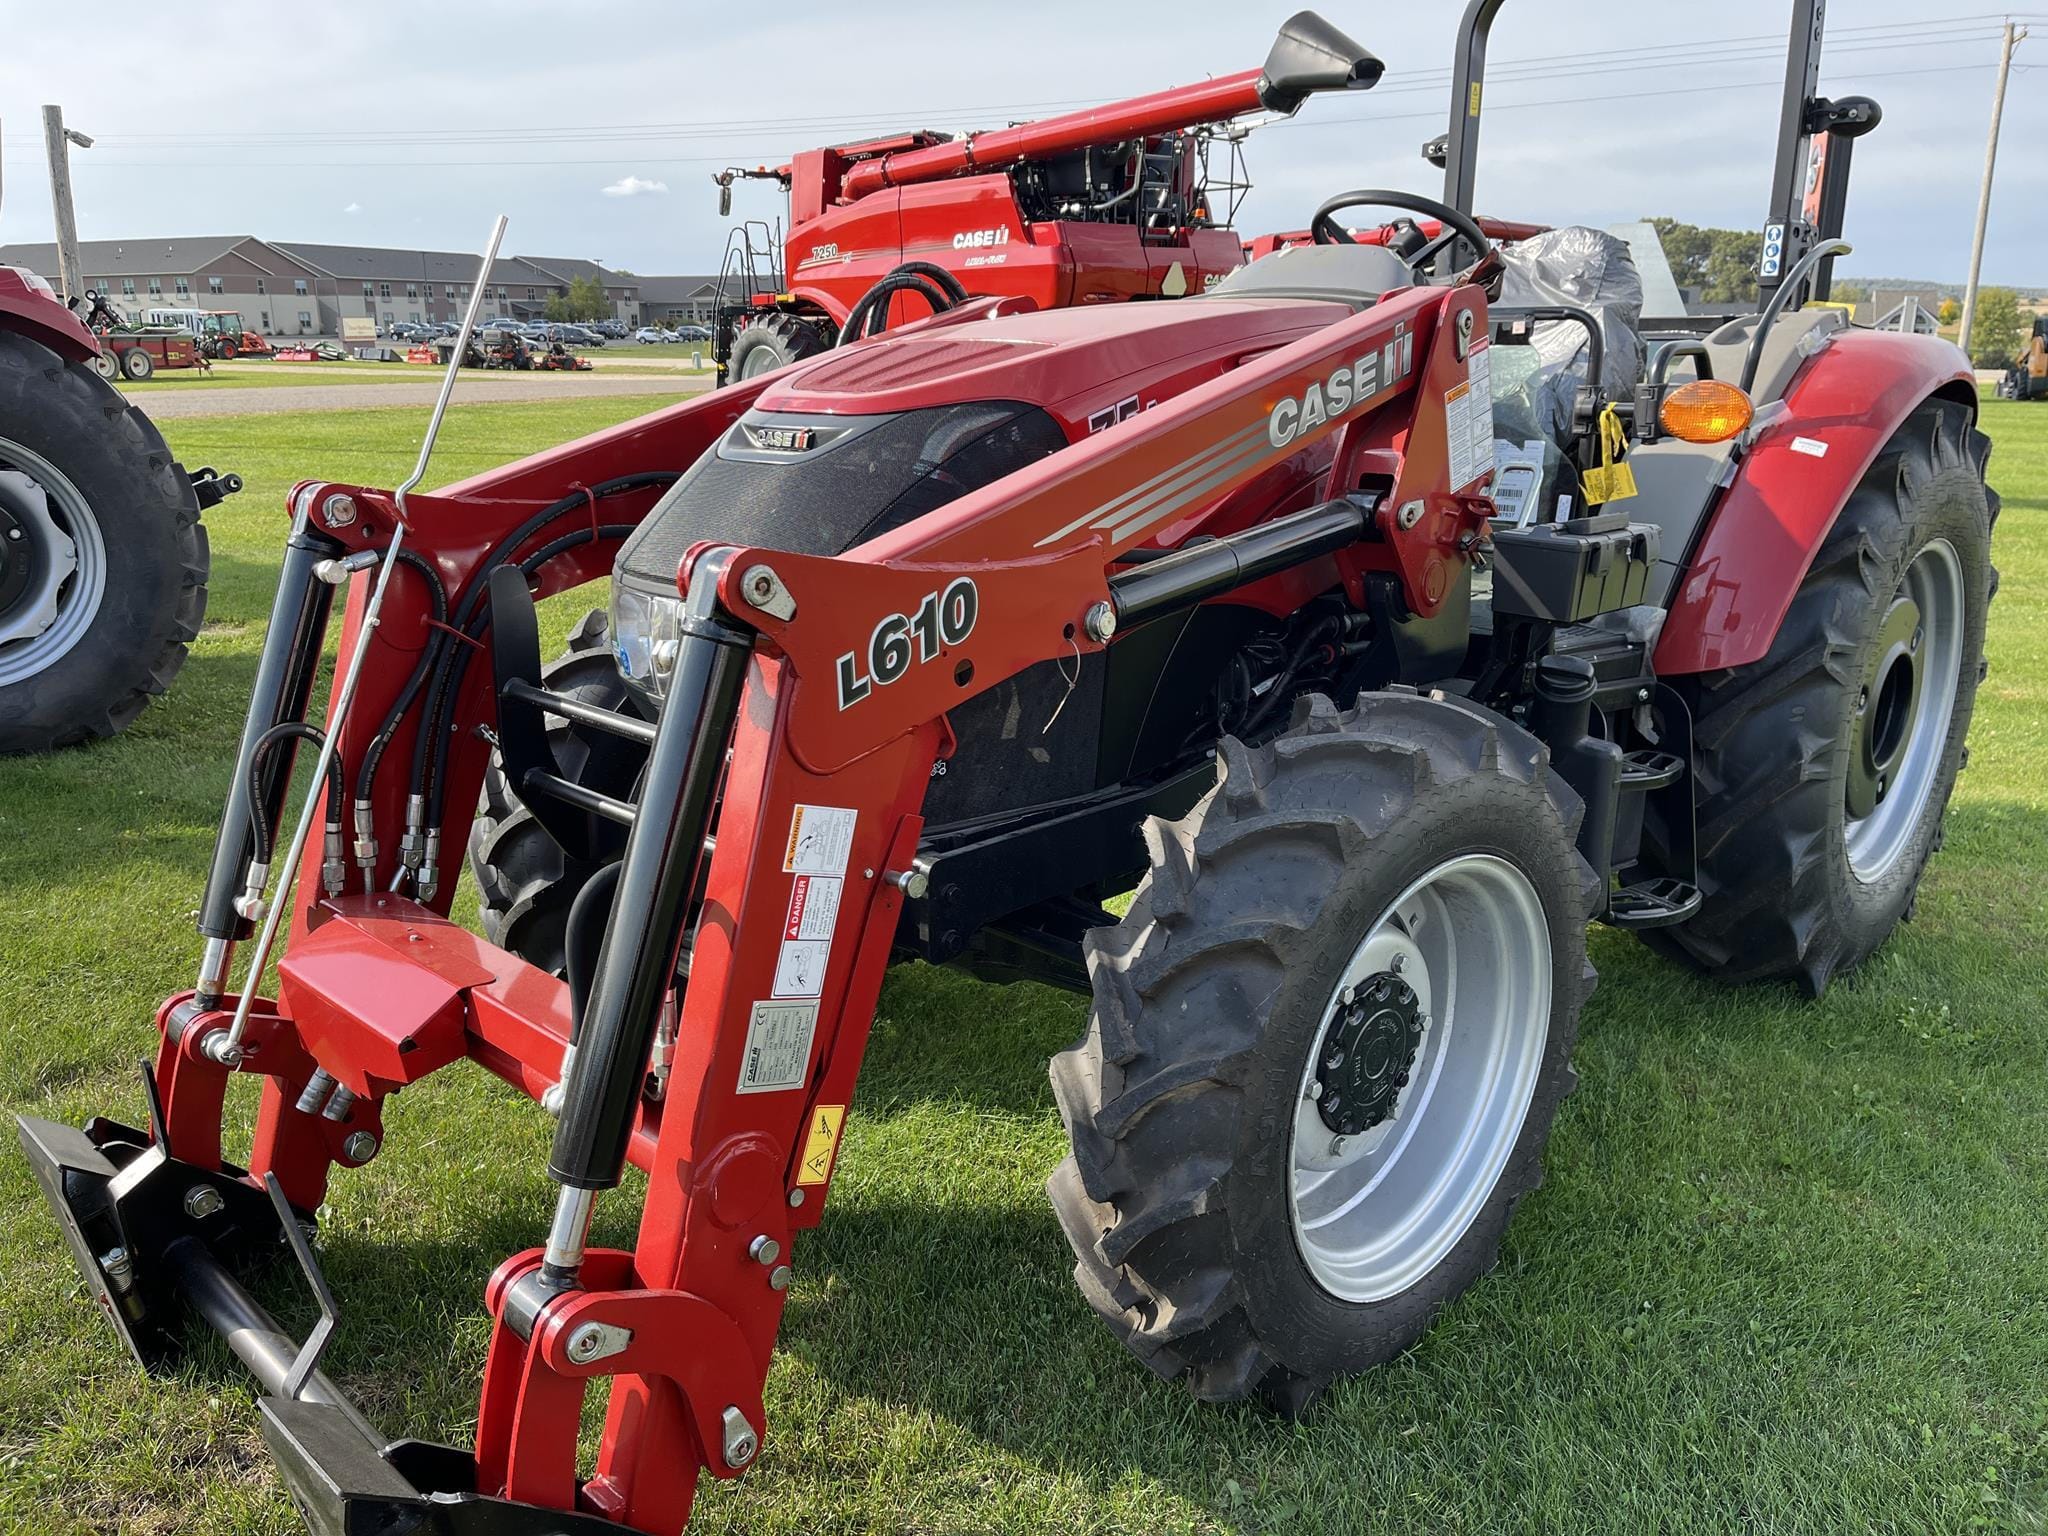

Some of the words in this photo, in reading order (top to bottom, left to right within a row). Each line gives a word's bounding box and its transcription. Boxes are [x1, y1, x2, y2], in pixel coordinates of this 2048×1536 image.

[812, 243, 838, 260] 7250
[953, 233, 994, 249] CASE
[1269, 351, 1378, 448] CASE
[757, 430, 794, 447] CASE
[836, 576, 978, 711] L610
[790, 811, 803, 853] WARNING
[792, 880, 808, 923] DANGER
[747, 1055, 757, 1081] CASE
